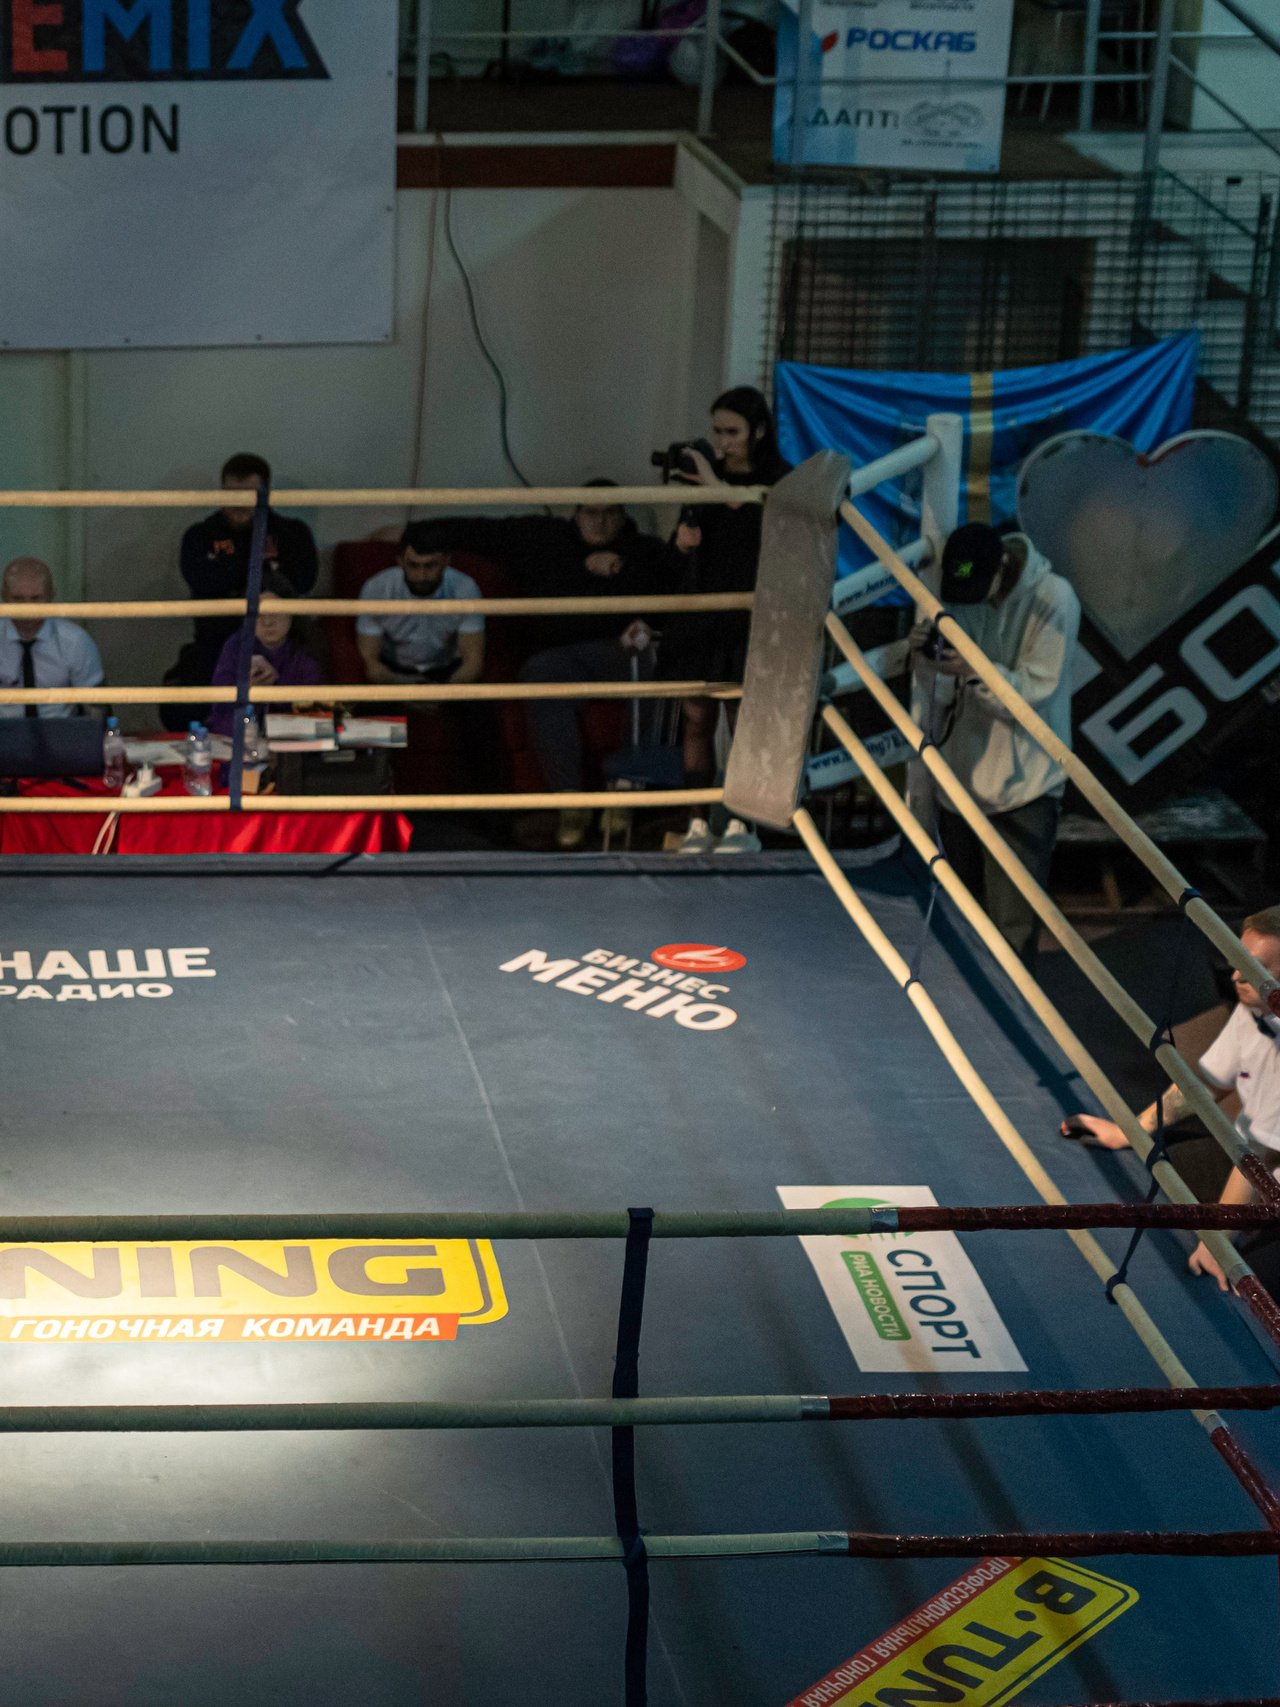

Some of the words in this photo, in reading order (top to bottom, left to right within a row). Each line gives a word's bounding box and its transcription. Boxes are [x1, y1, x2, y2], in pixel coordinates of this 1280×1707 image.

[846, 28, 977, 52] РОСКАБ
[498, 948, 738, 1031] МЕНЮ
[581, 948, 730, 1000] БИЗНЕС
[9, 1318, 220, 1338] ГОНОЧНАЯ
[241, 1317, 442, 1339] КОМАНДА
[848, 1253, 868, 1278] РИА
[862, 1279, 904, 1338] НОВОСТИ
[886, 1249, 982, 1359] СПОРТ
